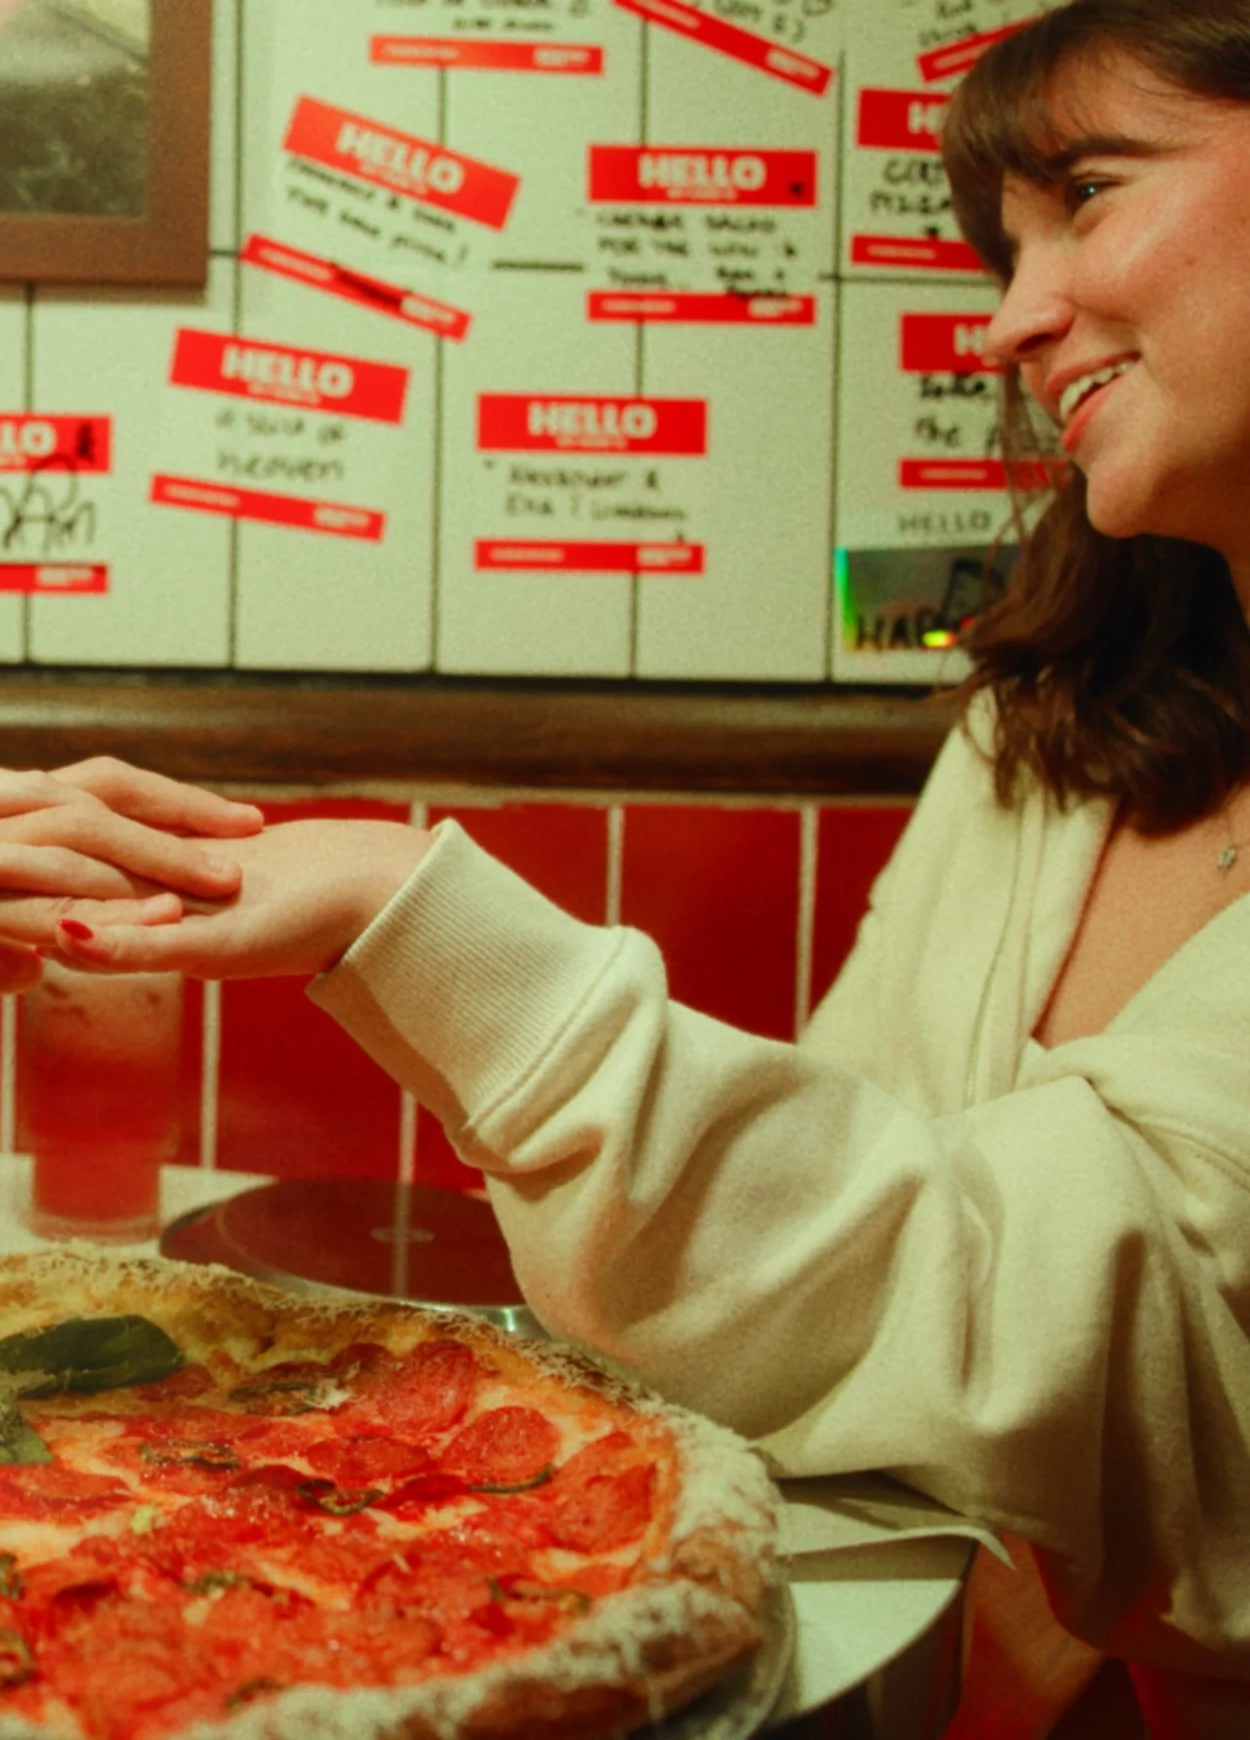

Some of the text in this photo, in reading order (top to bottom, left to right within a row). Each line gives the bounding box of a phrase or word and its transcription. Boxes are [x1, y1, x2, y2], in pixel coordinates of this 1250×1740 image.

[335, 122, 466, 194] HELLO
[639, 155, 766, 189] HELLO
[221, 344, 354, 397] HELLO
[528, 402, 655, 438] HELLO
[897, 511, 990, 536] HELLO
